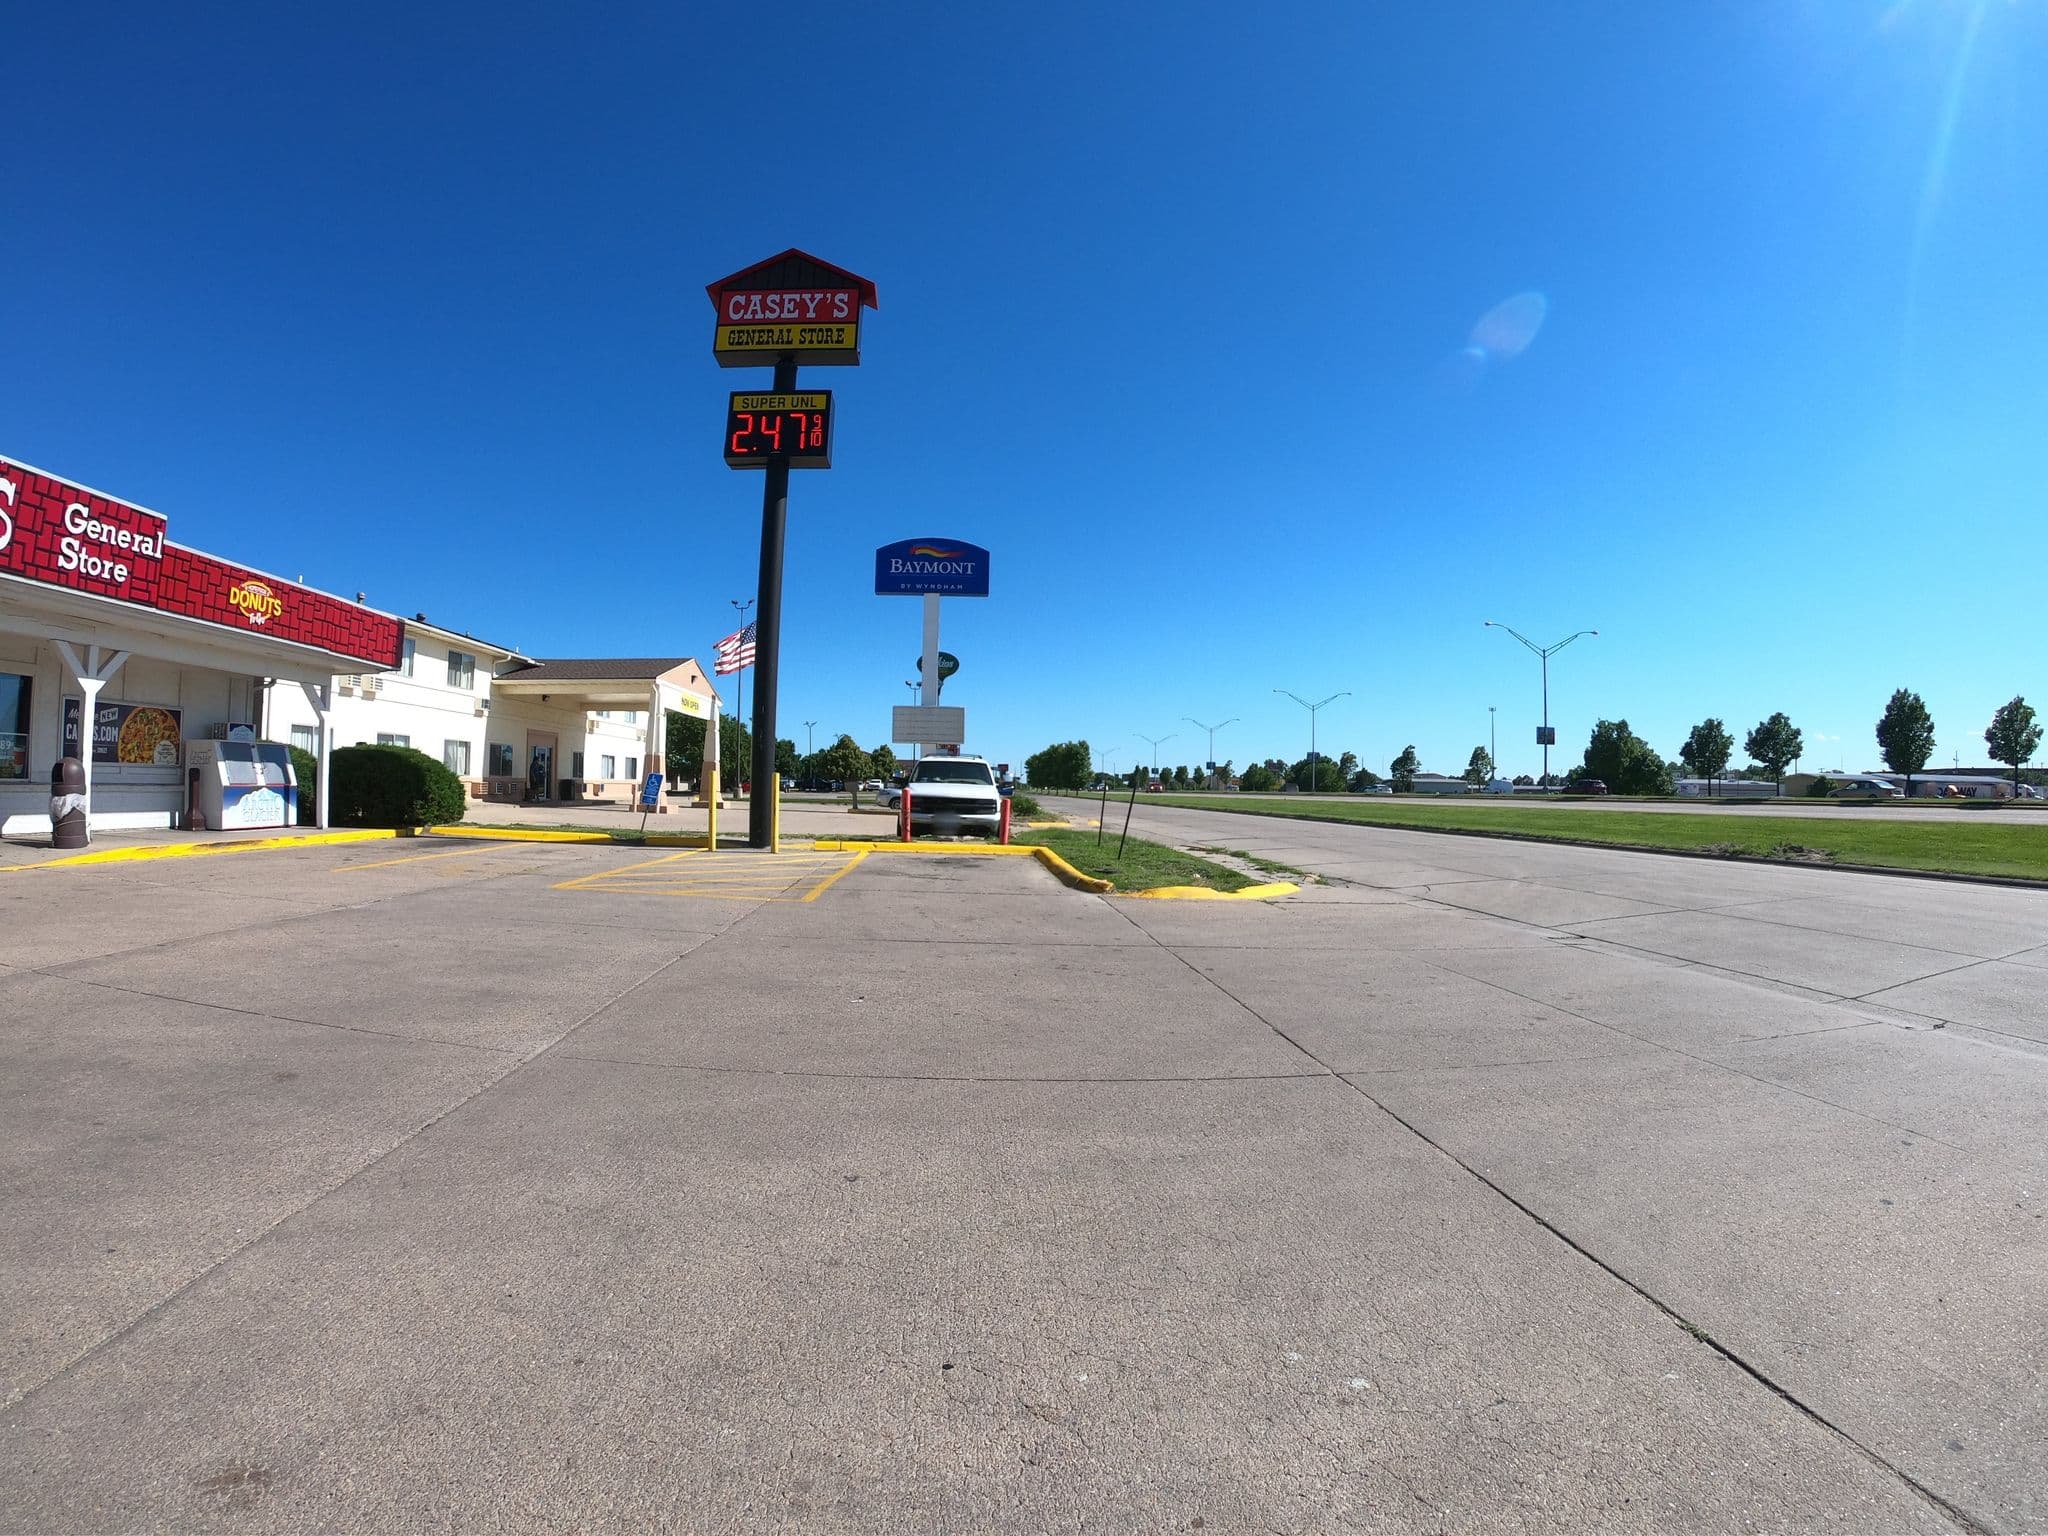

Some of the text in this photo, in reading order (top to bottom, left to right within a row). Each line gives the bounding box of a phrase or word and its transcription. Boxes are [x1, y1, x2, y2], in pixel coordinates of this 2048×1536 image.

[728, 293, 849, 320] CASEY'S
[728, 327, 846, 346] GENERAL STORE
[742, 396, 817, 409] SUPER UNL
[732, 413, 807, 453] 2.47
[64, 502, 164, 559] General
[57, 536, 128, 583] Store
[889, 558, 976, 575] BAYMONT
[229, 586, 282, 617] DONUTS
[101, 708, 118, 722] NEW
